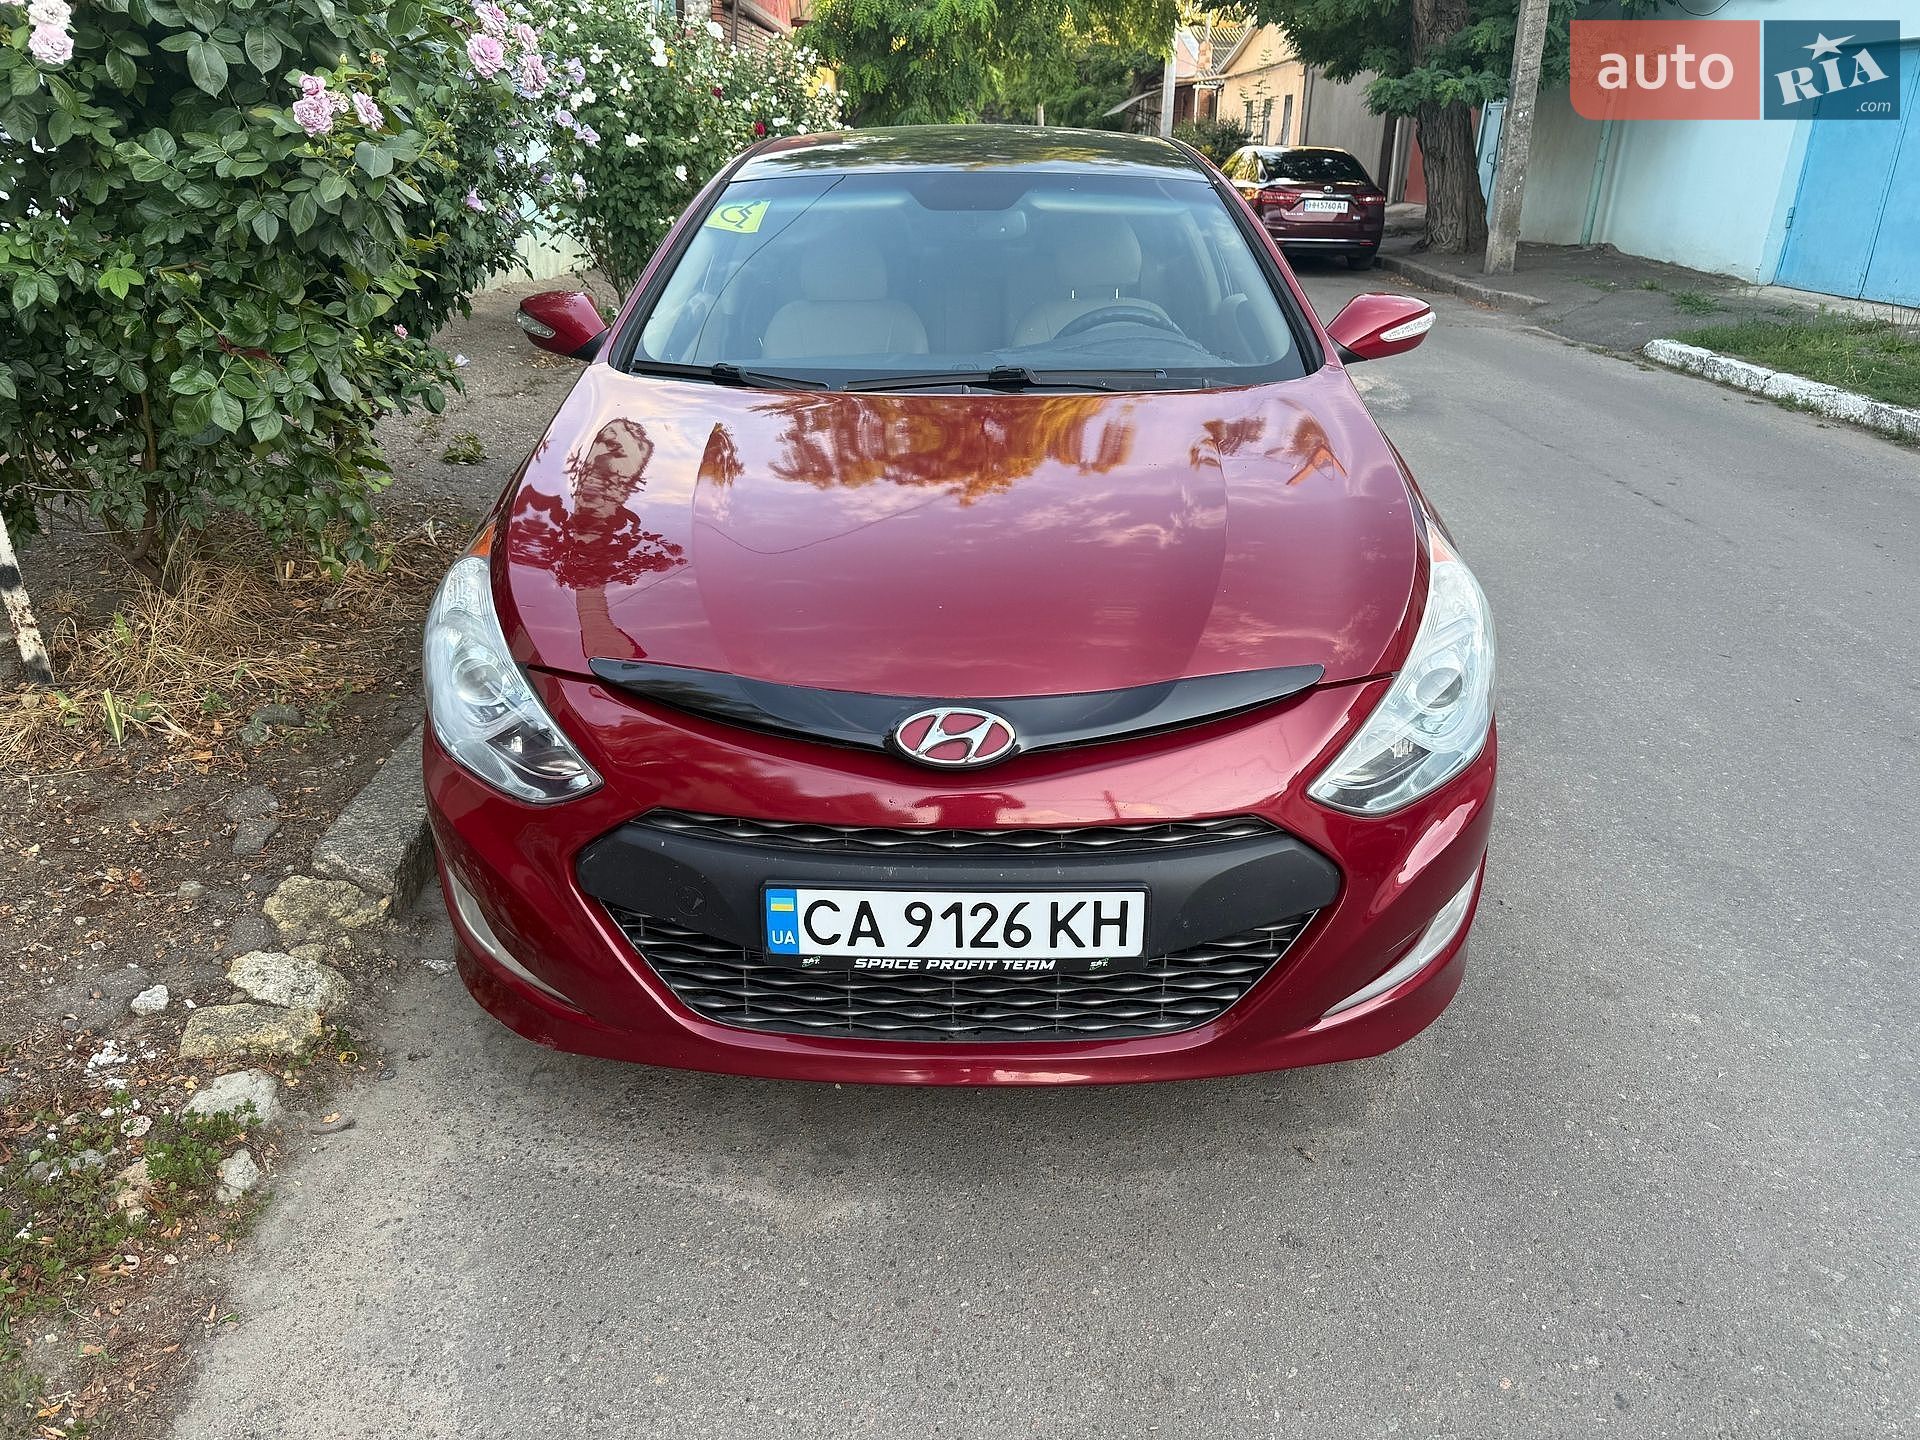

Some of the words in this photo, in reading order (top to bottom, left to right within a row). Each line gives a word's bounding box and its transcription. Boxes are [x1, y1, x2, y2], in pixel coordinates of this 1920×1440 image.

[803, 899, 885, 948] CA
[904, 901, 1032, 949] 9126
[1049, 900, 1129, 949] KH
[772, 930, 796, 944] UA
[854, 958, 921, 970] SPACE
[926, 958, 998, 970] PROFIT
[1003, 959, 1056, 971] TEAM
